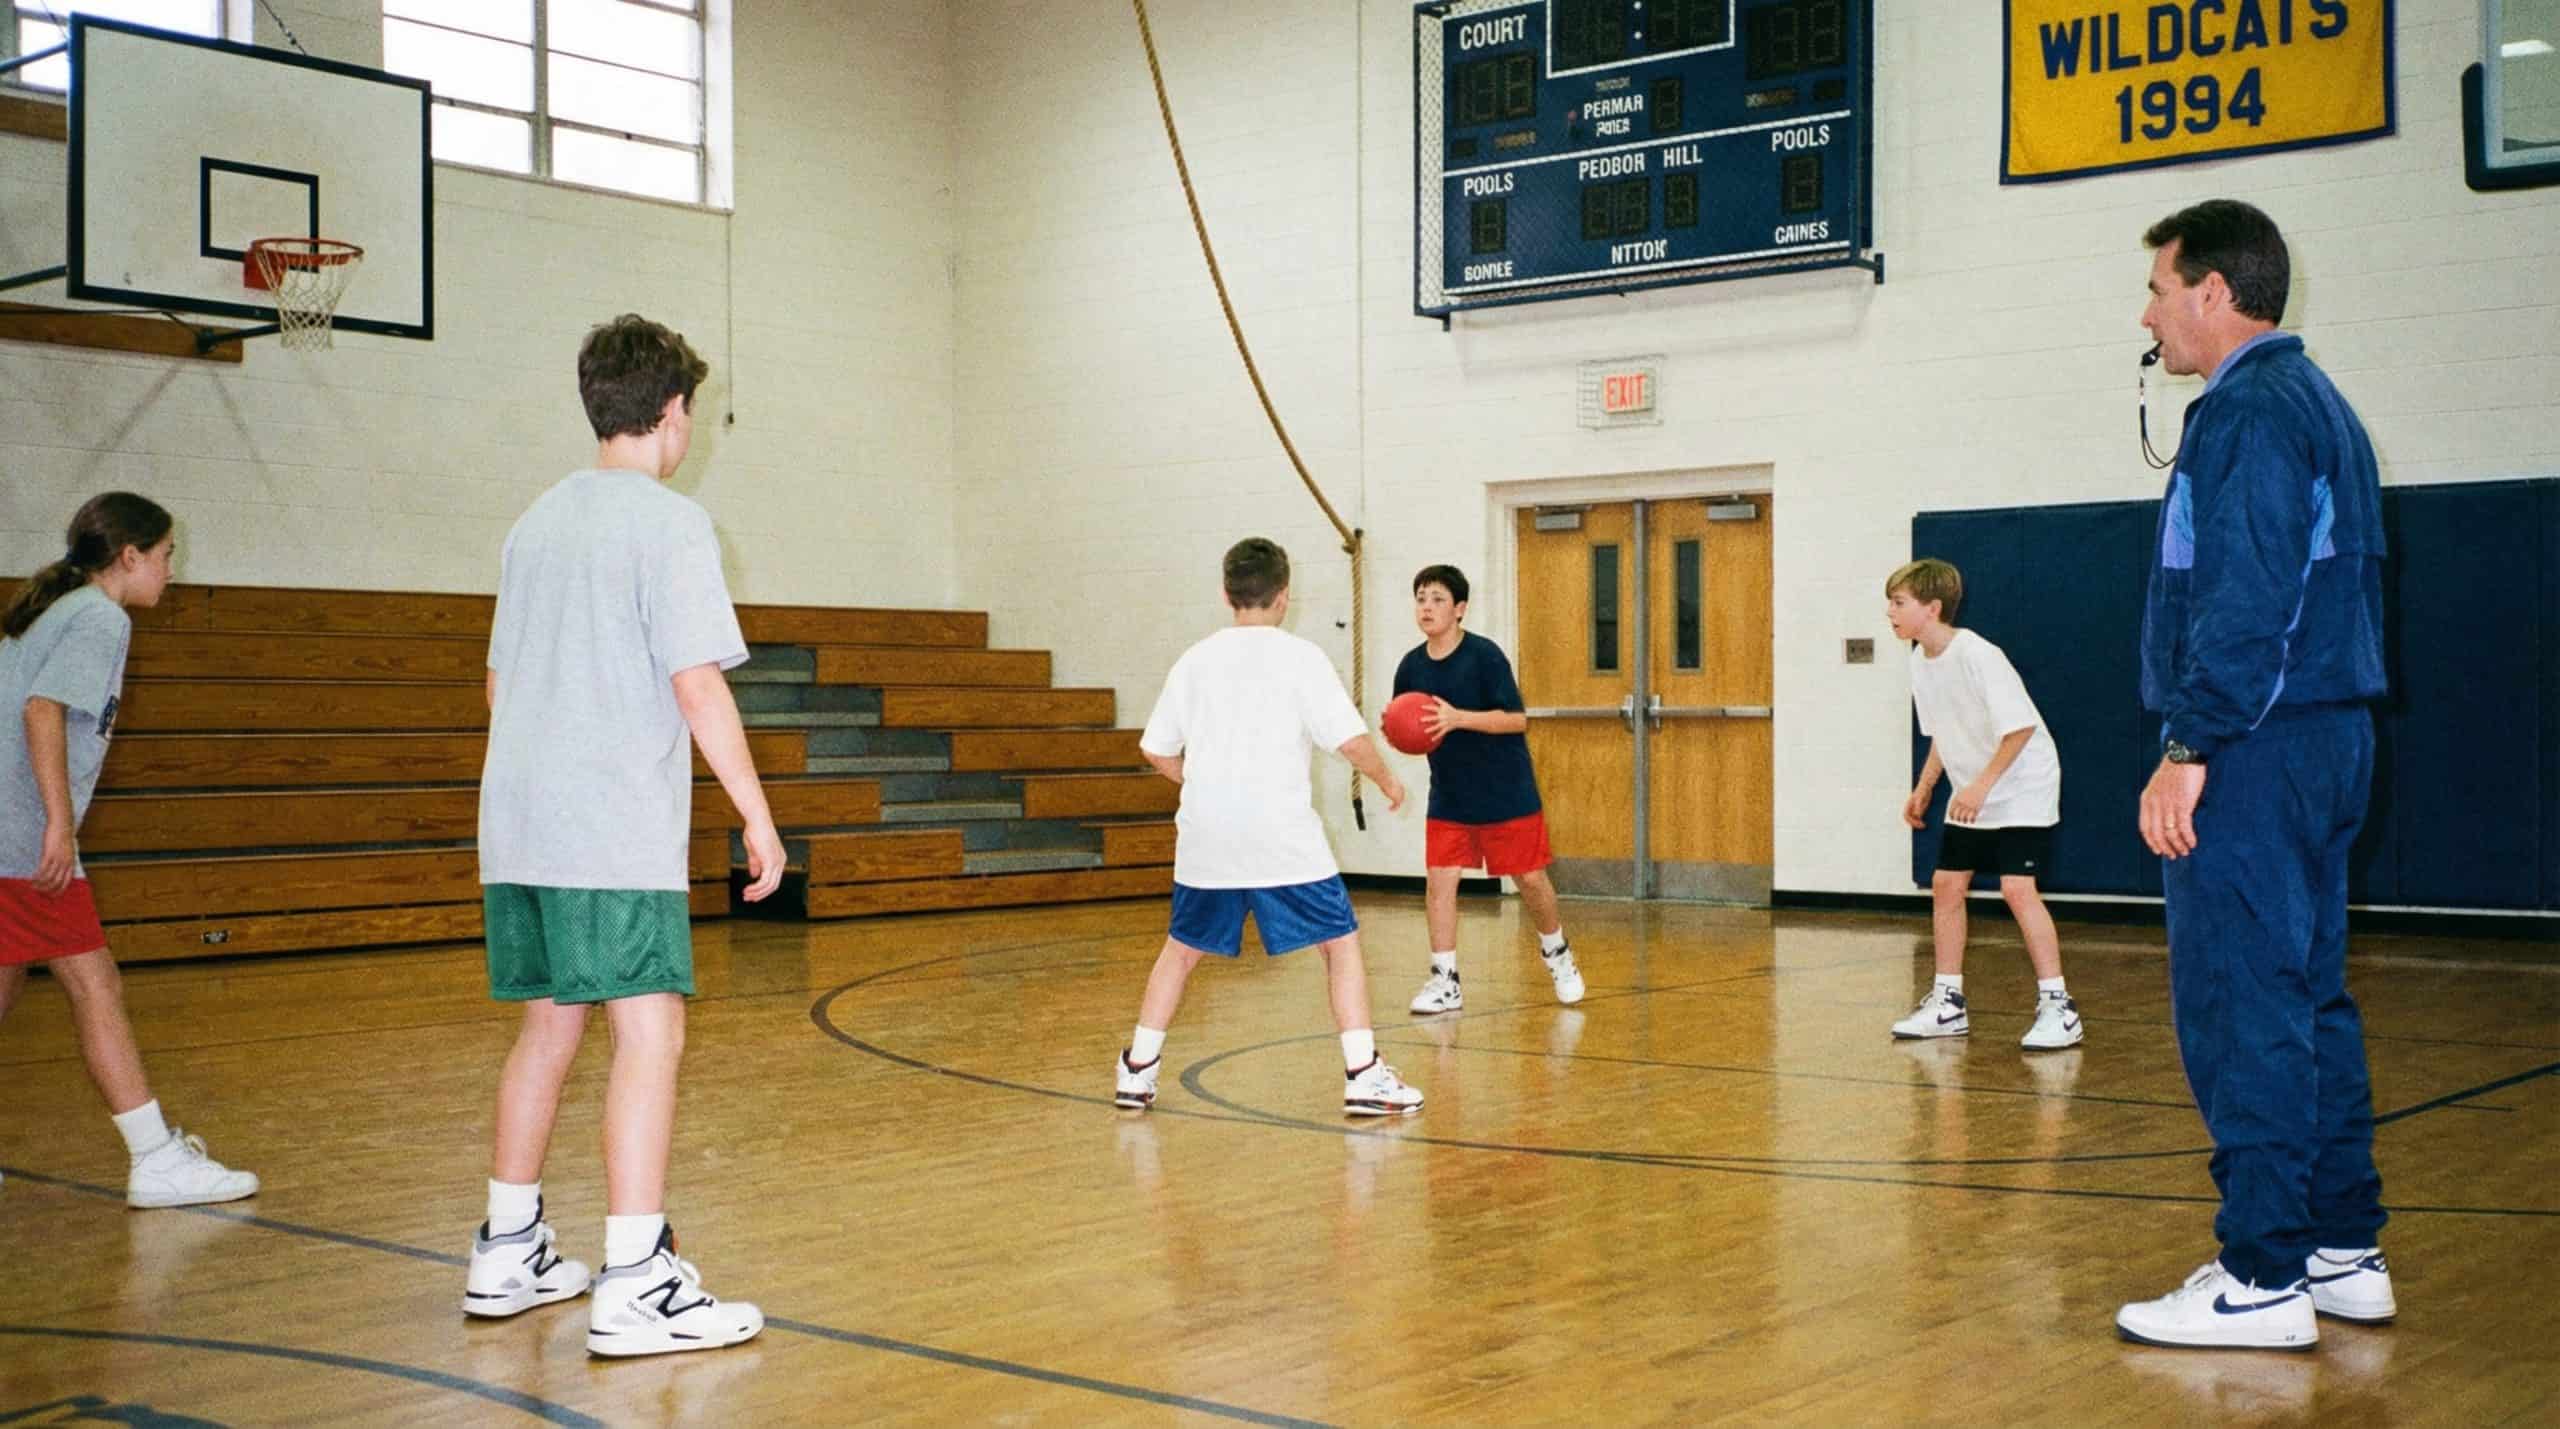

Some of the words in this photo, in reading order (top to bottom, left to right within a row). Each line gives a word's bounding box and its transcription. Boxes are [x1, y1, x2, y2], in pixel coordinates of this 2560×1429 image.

[1460, 14, 1527, 50] COURT
[2039, 0, 2349, 80] WILDCATS
[1583, 94, 1643, 120] PERMAR
[2115, 67, 2266, 143] 1994
[1772, 124, 1830, 152] POOLS
[1579, 152, 1645, 181] PEDBOR
[1664, 144, 1703, 168] HILL
[1463, 172, 1514, 197] POOLS
[1605, 373, 1647, 410] EXIT
